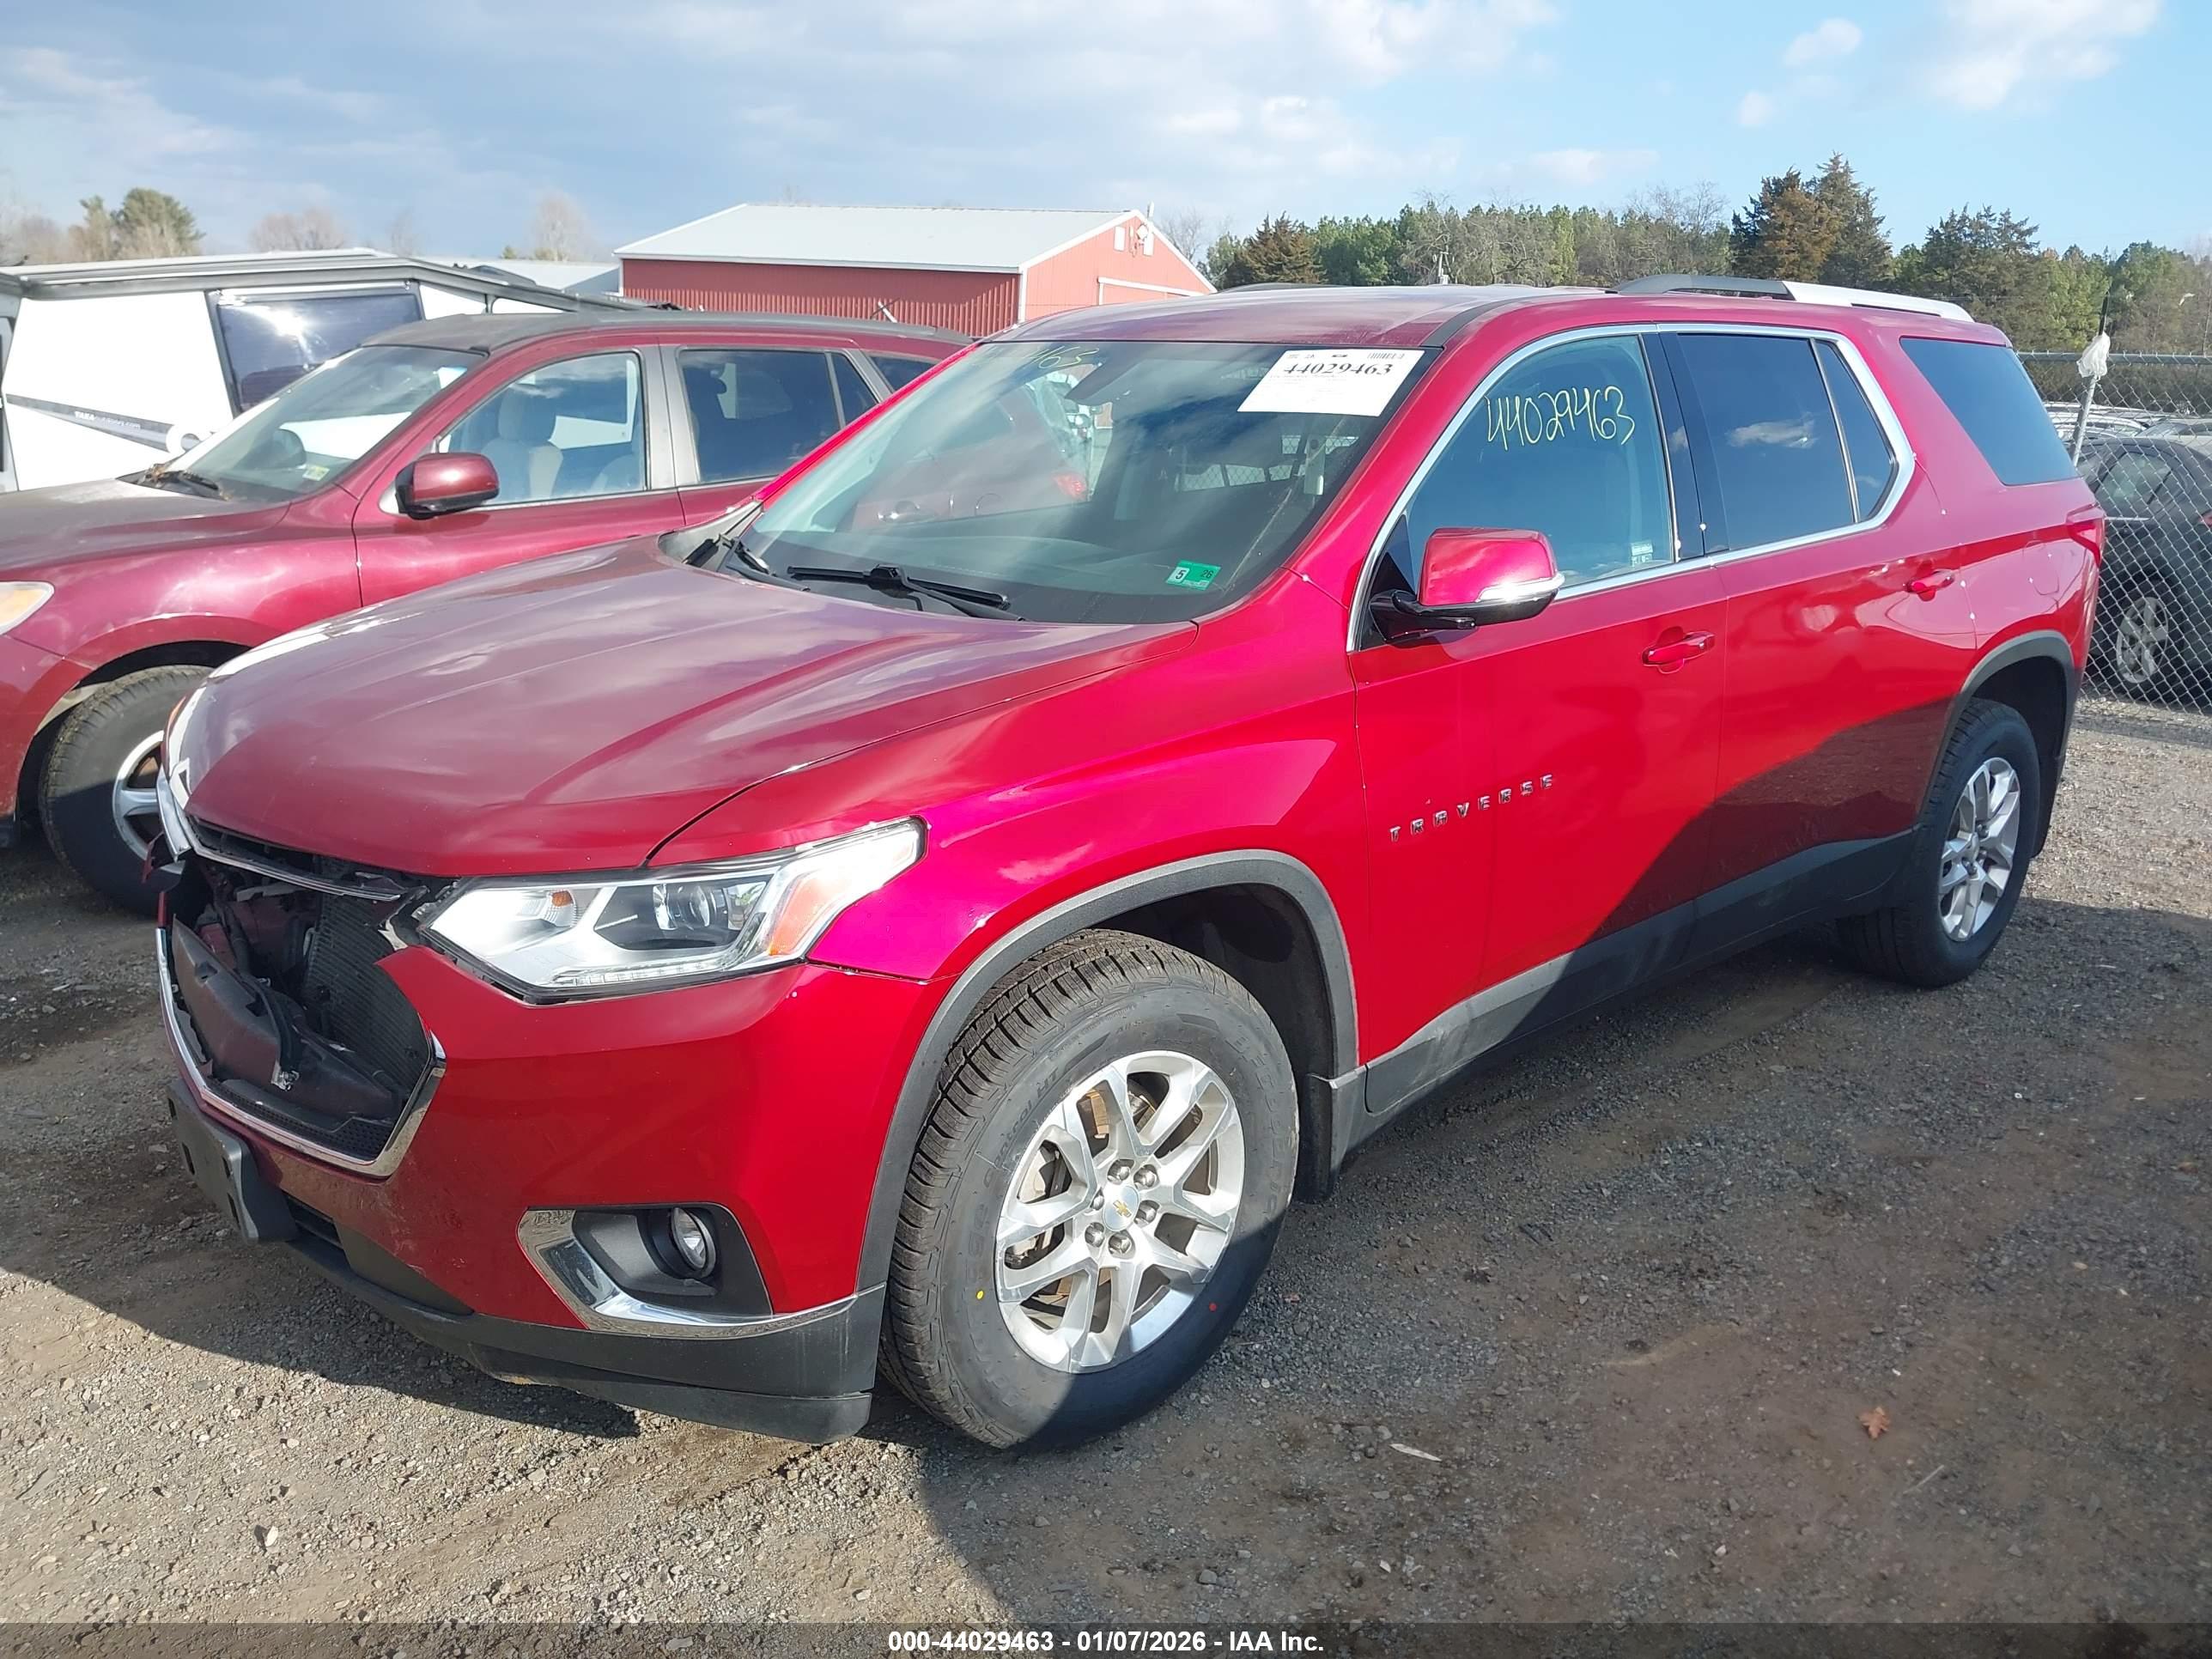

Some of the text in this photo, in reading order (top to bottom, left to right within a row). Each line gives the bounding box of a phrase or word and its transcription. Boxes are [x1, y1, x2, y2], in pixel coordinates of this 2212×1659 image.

[1284, 362, 1394, 375] 44029463
[1483, 386, 1636, 452] 44029463
[1175, 568, 1187, 580] 5
[1389, 774, 1553, 842] TRAVERSE
